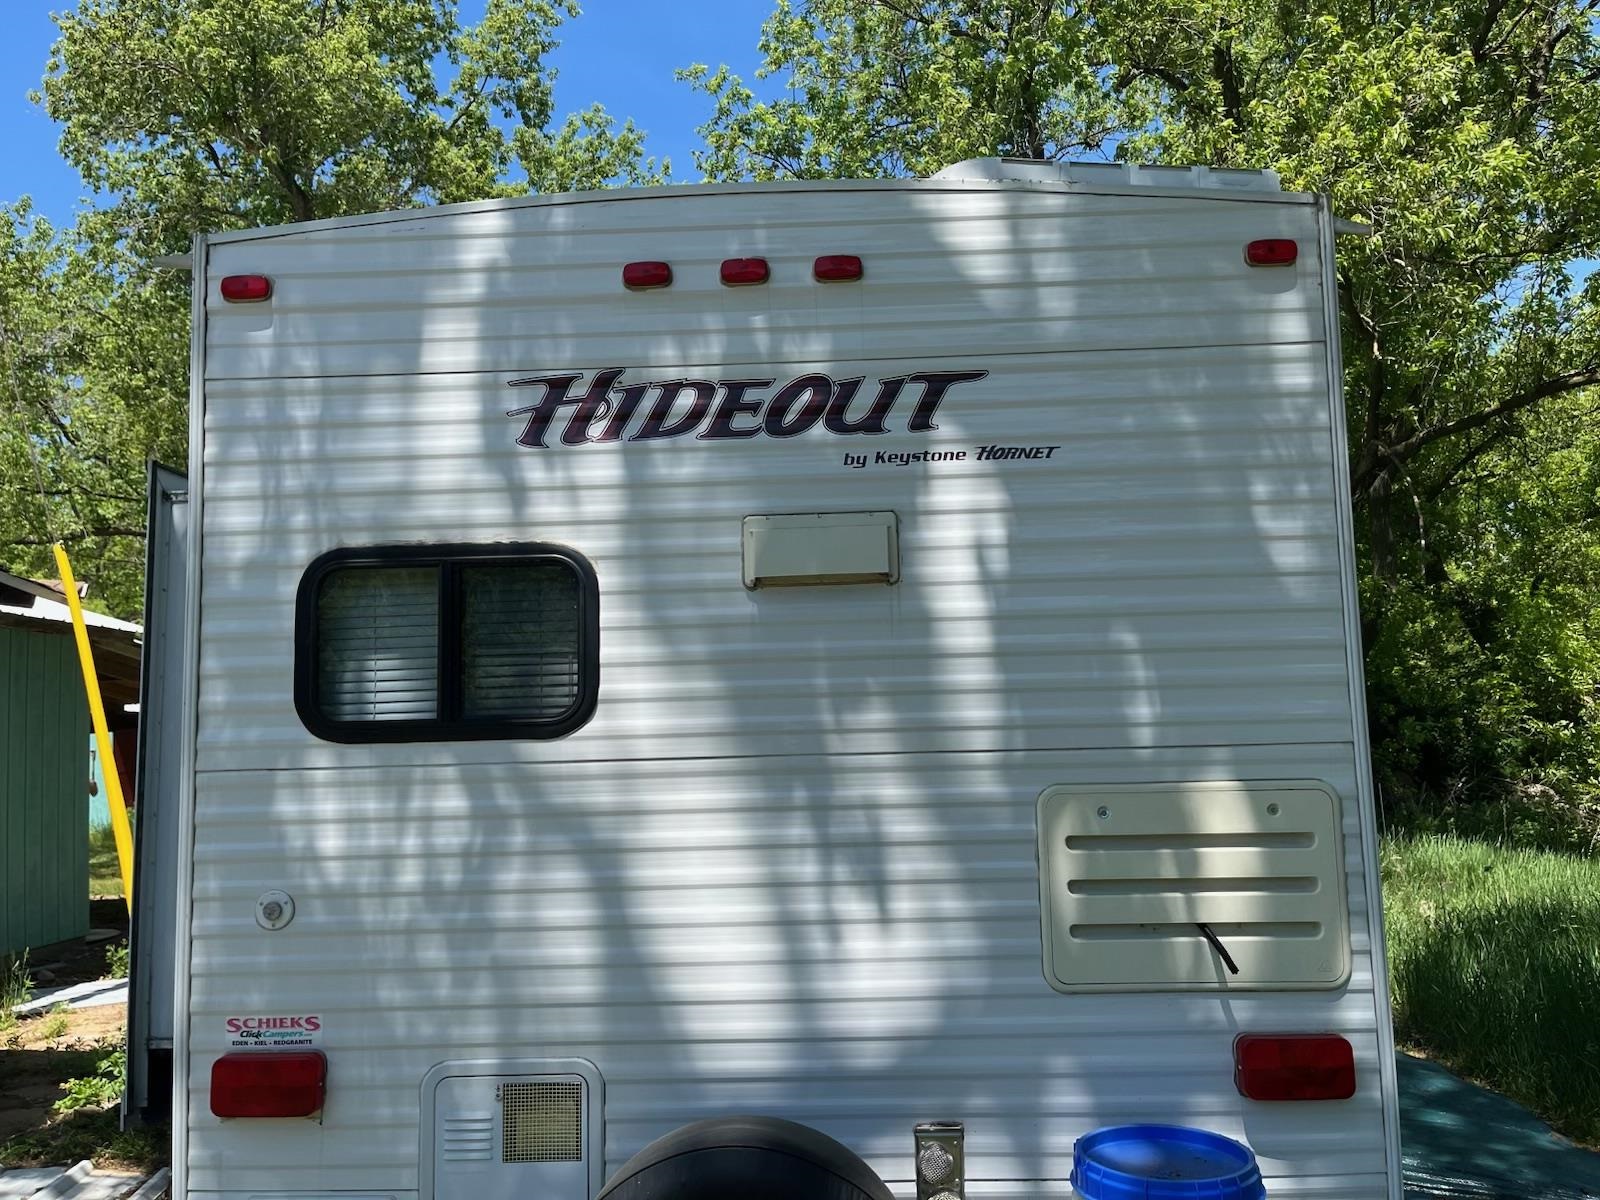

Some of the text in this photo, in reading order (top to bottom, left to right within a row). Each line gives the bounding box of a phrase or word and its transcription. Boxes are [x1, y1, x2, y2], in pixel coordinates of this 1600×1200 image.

[506, 368, 990, 449] HIDEOUT
[843, 445, 1062, 468] by Keystone HORNET
[226, 1016, 321, 1033] SCHIEKS
